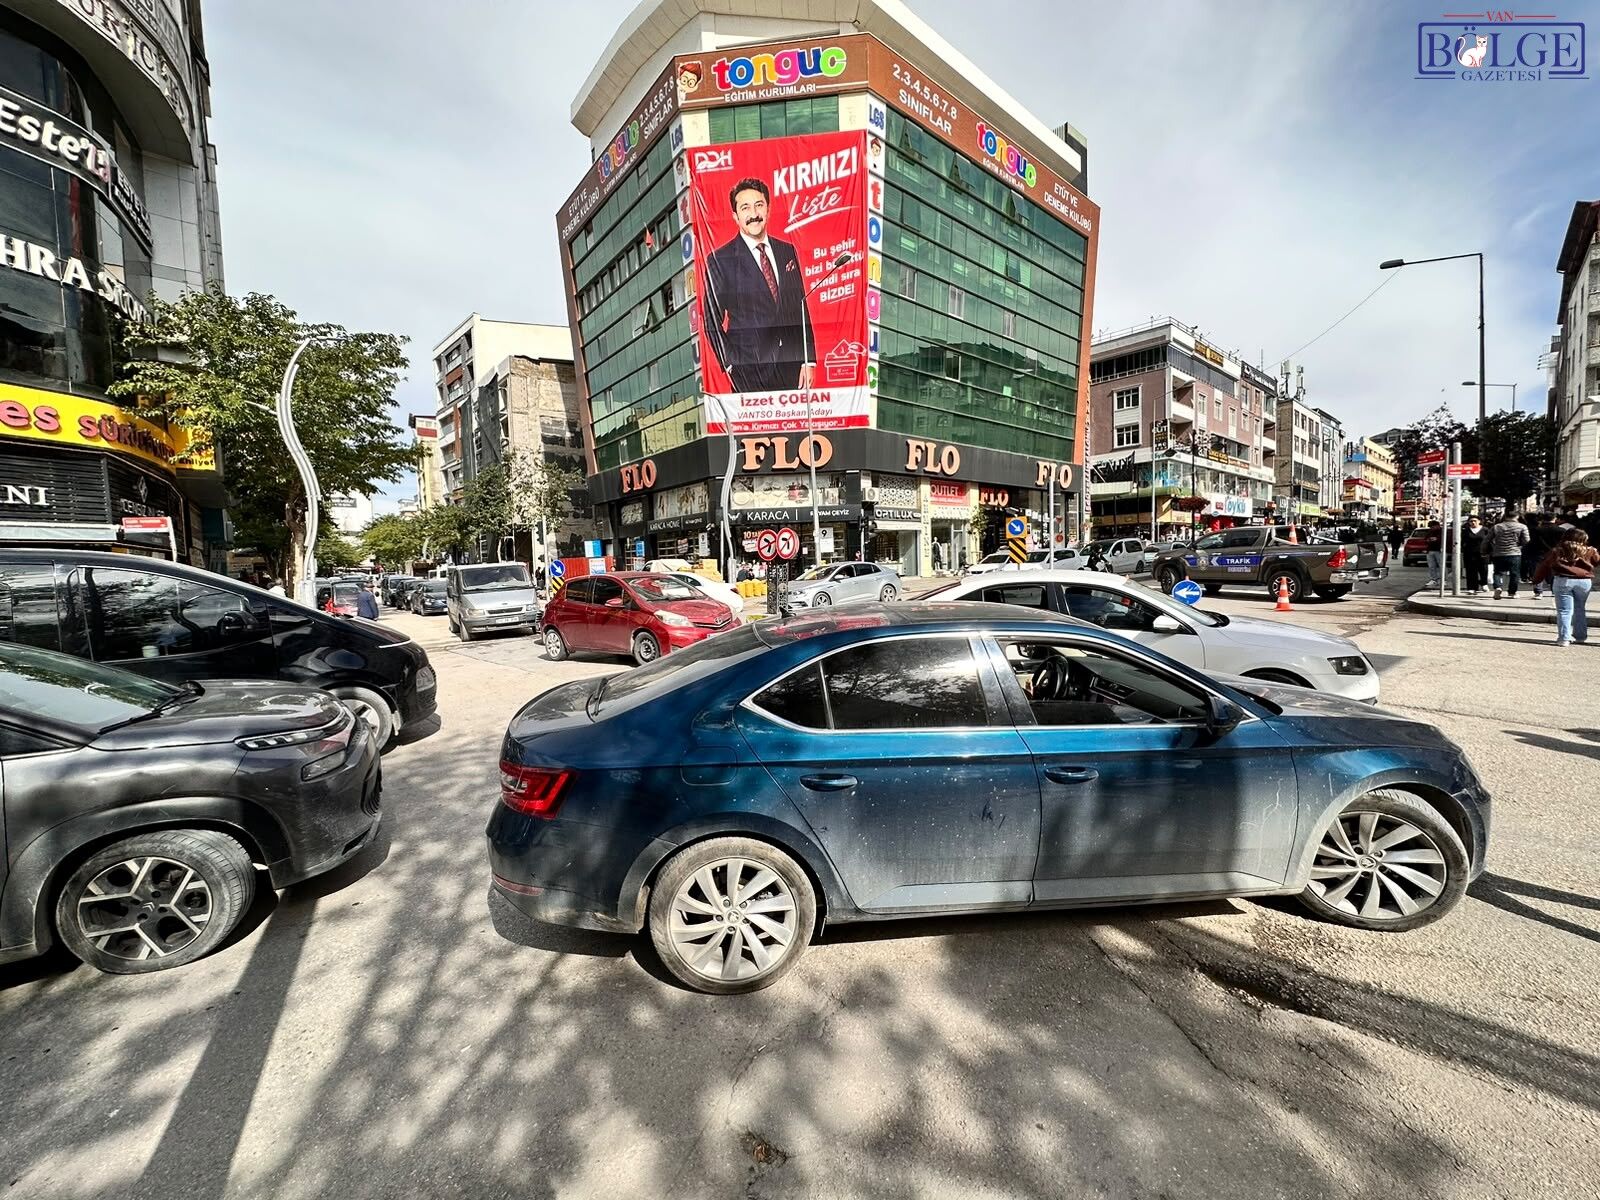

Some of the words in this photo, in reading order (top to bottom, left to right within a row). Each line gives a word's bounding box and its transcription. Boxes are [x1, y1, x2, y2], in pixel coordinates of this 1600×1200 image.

[711, 46, 848, 91] tonguc
[724, 88, 757, 102] EĞİTİM
[758, 84, 816, 98] KURUMLARI
[892, 63, 958, 120] 2.3.4.5.6.7.8
[644, 97, 673, 140] SINIFLAR
[868, 103, 885, 130] LGS
[899, 89, 953, 136] SINIFLAR
[976, 120, 1037, 188] tonguc
[773, 146, 859, 198] KIRMIZI
[786, 185, 844, 225] Liste
[1070, 194, 1078, 208] VE
[814, 248, 828, 259] Bu
[830, 238, 856, 256] şehir
[805, 262, 823, 277] bizi
[841, 268, 861, 282] sıra
[820, 282, 855, 302] BİZDE!
[740, 394, 774, 408] İzzet
[779, 391, 831, 406] ÇOBAN
[738, 410, 773, 420] VANTSO
[776, 408, 806, 418] Başkan
[752, 420, 780, 431] Kırmızı
[782, 420, 797, 430] Çok
[741, 434, 833, 471] FLO
[905, 439, 961, 476] FLO
[620, 458, 657, 493] FLO
[930, 484, 959, 496] OUTLET
[746, 510, 790, 520] KARACA
[876, 508, 913, 520] OPTILUX
